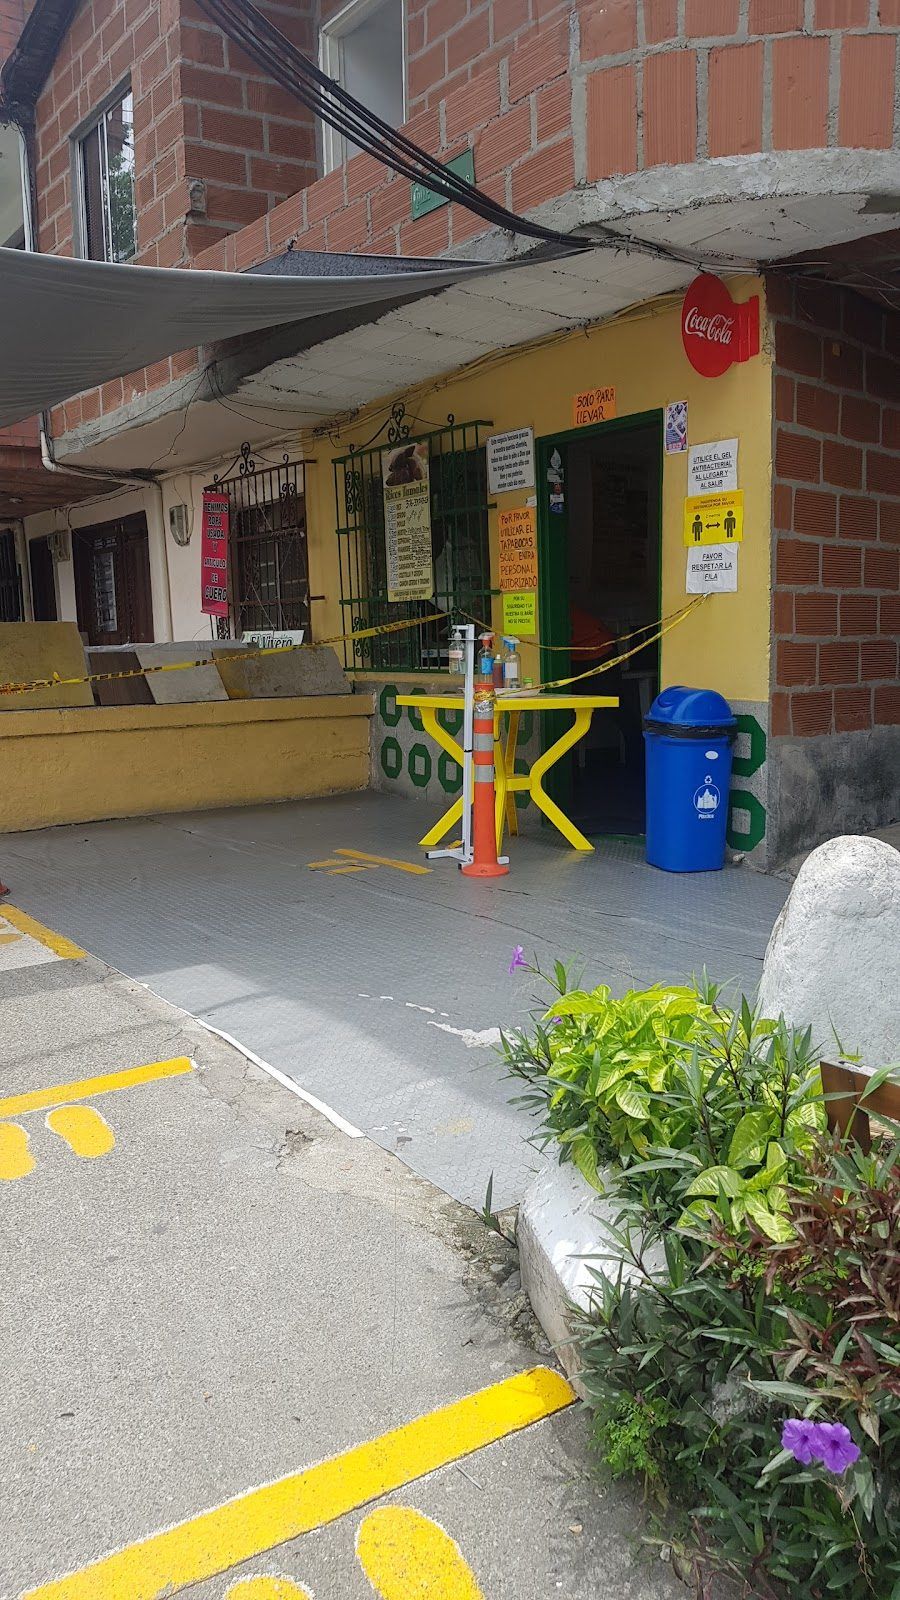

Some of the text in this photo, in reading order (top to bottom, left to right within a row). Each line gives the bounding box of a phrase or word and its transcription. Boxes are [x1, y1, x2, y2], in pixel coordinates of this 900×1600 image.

[684, 306, 735, 344] Coca-Cola
[596, 388, 615, 402] PARA
[693, 451, 732, 464] UTILICE EL GEL
[692, 461, 732, 473] ANTIBACTERIAL
[702, 471, 723, 480] LLEGAR
[707, 480, 723, 488] SALIR
[526, 524, 534, 533] EL
[500, 537, 533, 551] TAPABOCAS
[703, 553, 723, 561] FAVOR
[501, 564, 535, 576] PERSONAL
[691, 563, 723, 571] RESPETAR
[500, 575, 537, 589] AUTORIZADO
[704, 573, 718, 581] FILA
